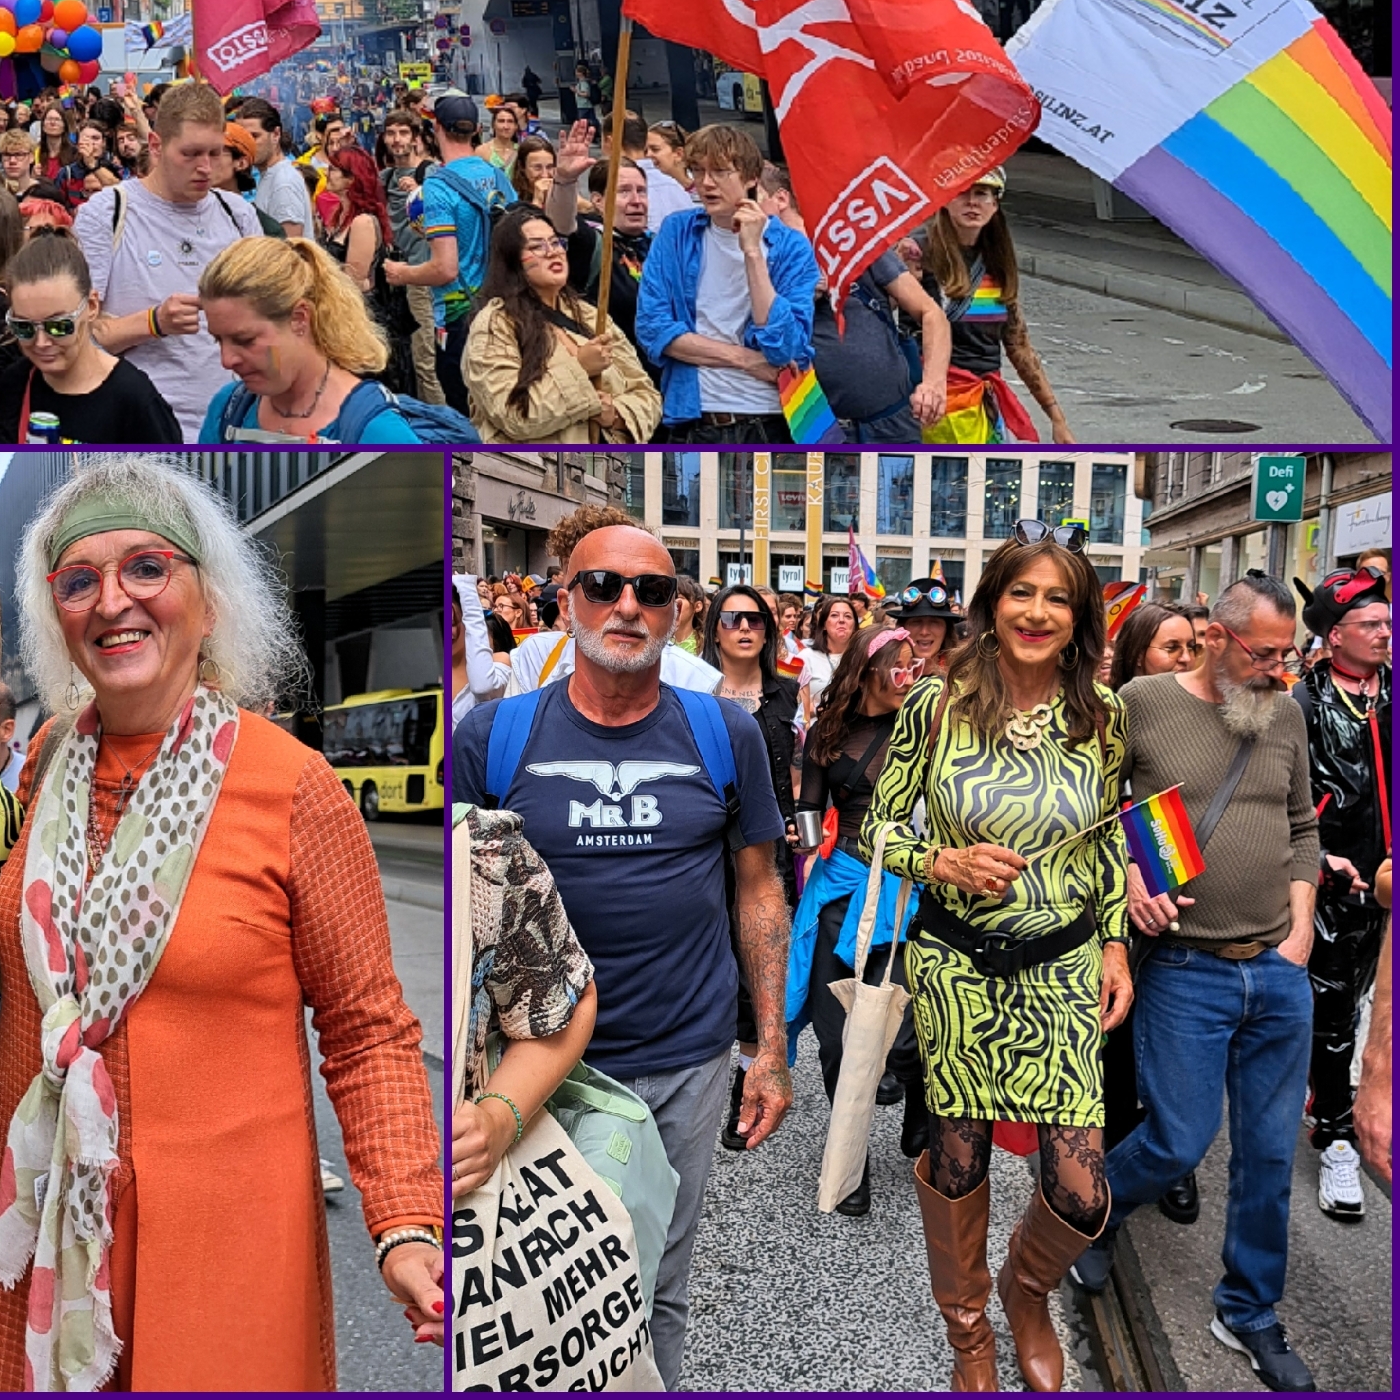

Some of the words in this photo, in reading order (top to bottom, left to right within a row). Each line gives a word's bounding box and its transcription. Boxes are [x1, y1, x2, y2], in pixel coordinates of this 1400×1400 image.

[1269, 465, 1294, 478] Defi
[754, 485, 769, 540] FIRST
[665, 538, 697, 548] MPREIS
[782, 570, 800, 583] tyrol
[630, 795, 664, 828] B
[576, 833, 652, 847] AMSTERDAM
[452, 1189, 609, 1318] ANFACH
[455, 1311, 534, 1372] IEL
[542, 1234, 631, 1325] MEHR
[463, 1273, 645, 1392] RSORGE
